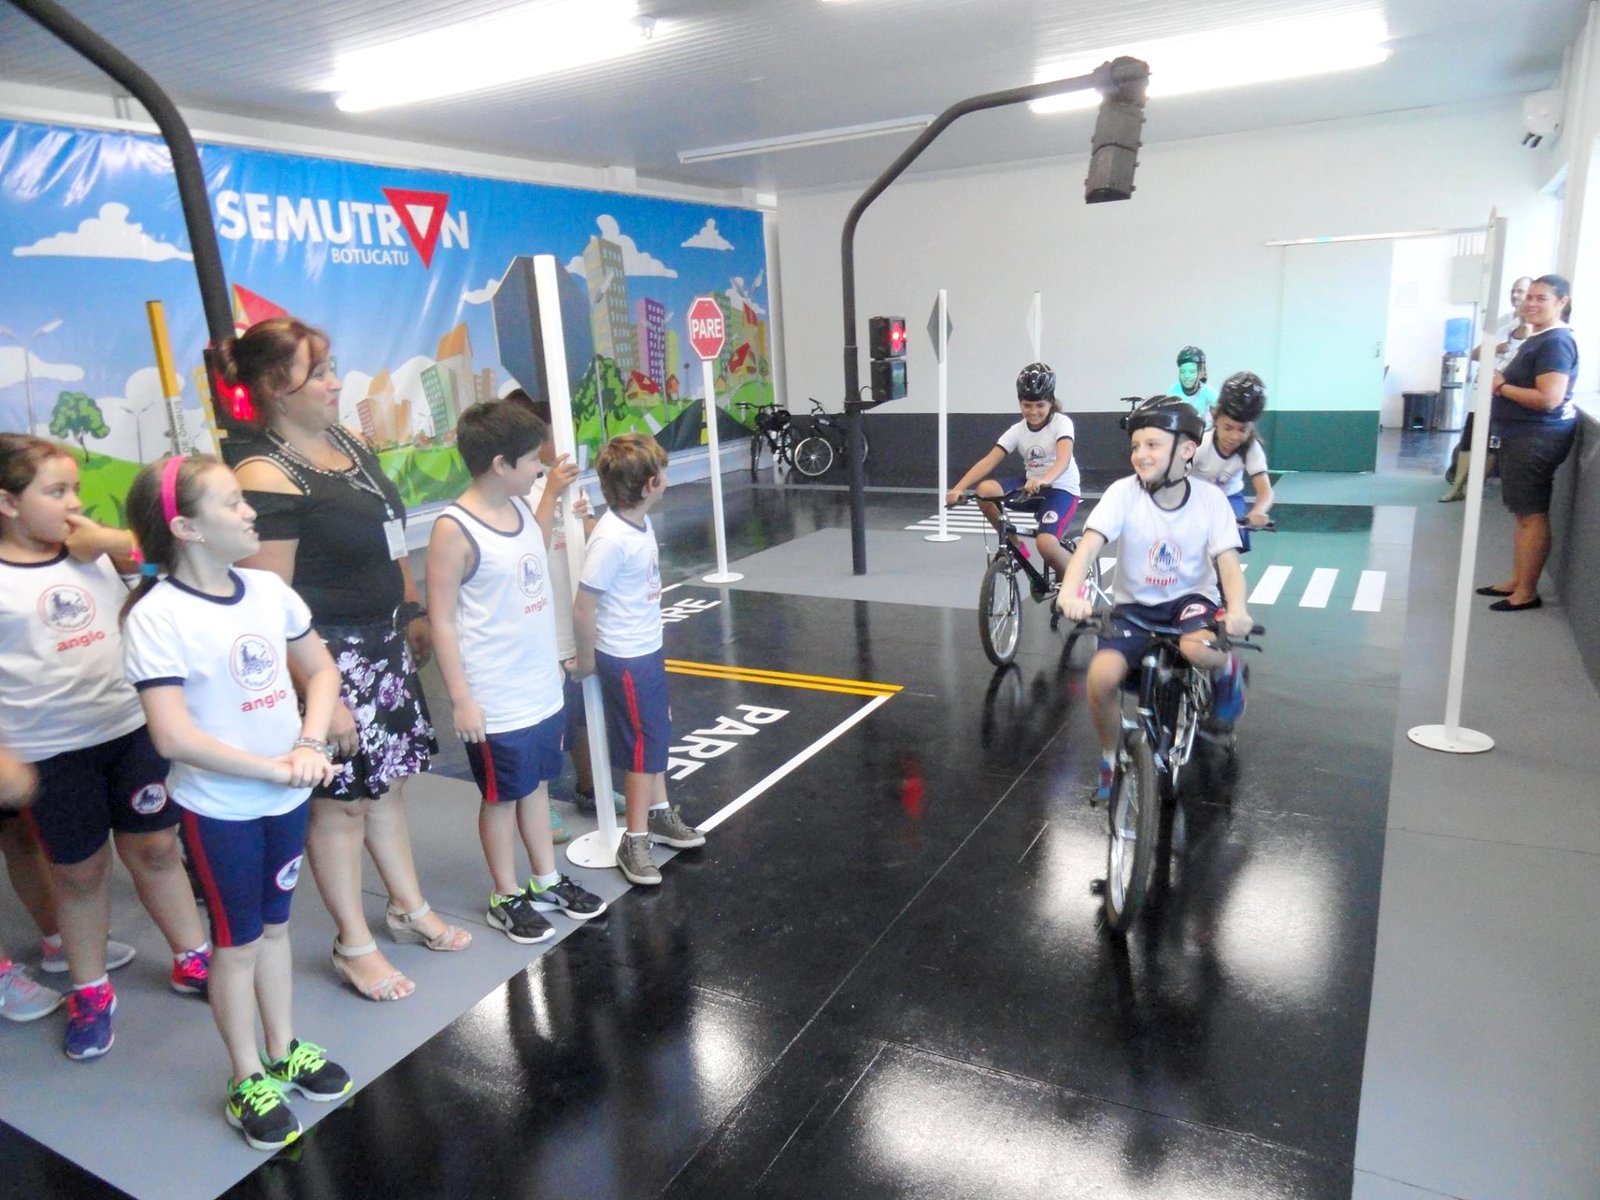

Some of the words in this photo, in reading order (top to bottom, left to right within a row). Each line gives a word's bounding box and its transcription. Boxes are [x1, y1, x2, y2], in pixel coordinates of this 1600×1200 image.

[332, 248, 409, 265] BOTUCATU
[692, 318, 722, 339] PARE
[57, 631, 105, 651] anglo
[241, 689, 287, 712] anglo
[667, 704, 790, 780] PARE
